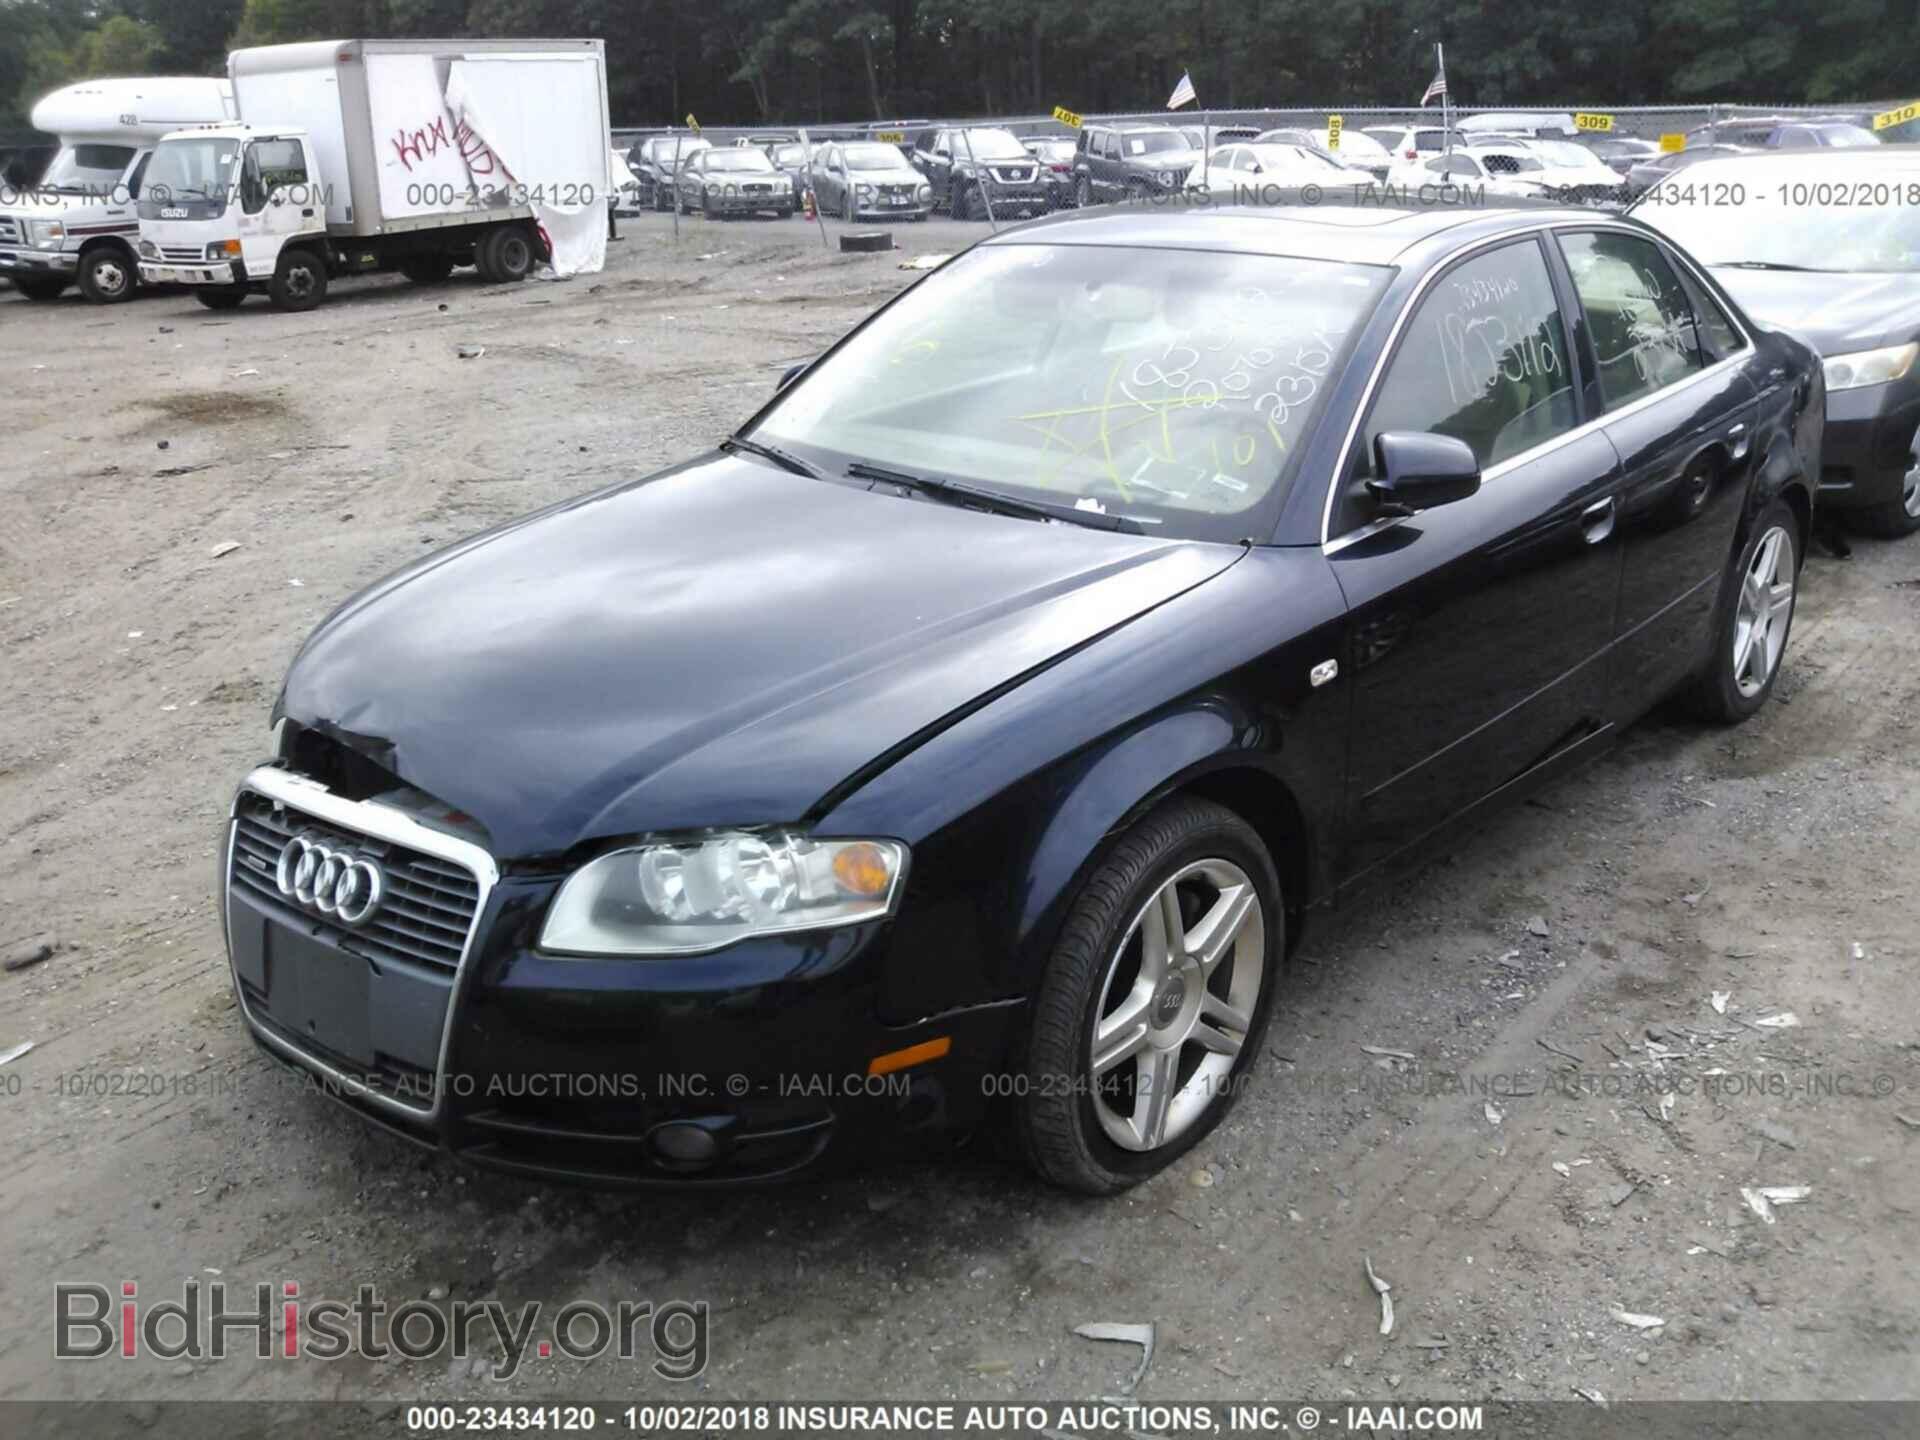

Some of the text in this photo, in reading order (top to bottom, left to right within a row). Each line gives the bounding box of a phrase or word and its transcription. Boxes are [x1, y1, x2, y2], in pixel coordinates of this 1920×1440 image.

[1578, 115, 1609, 131] 309
[1880, 105, 1917, 127] 310
[1329, 119, 1342, 148] 308
[161, 208, 189, 218] ISUZU
